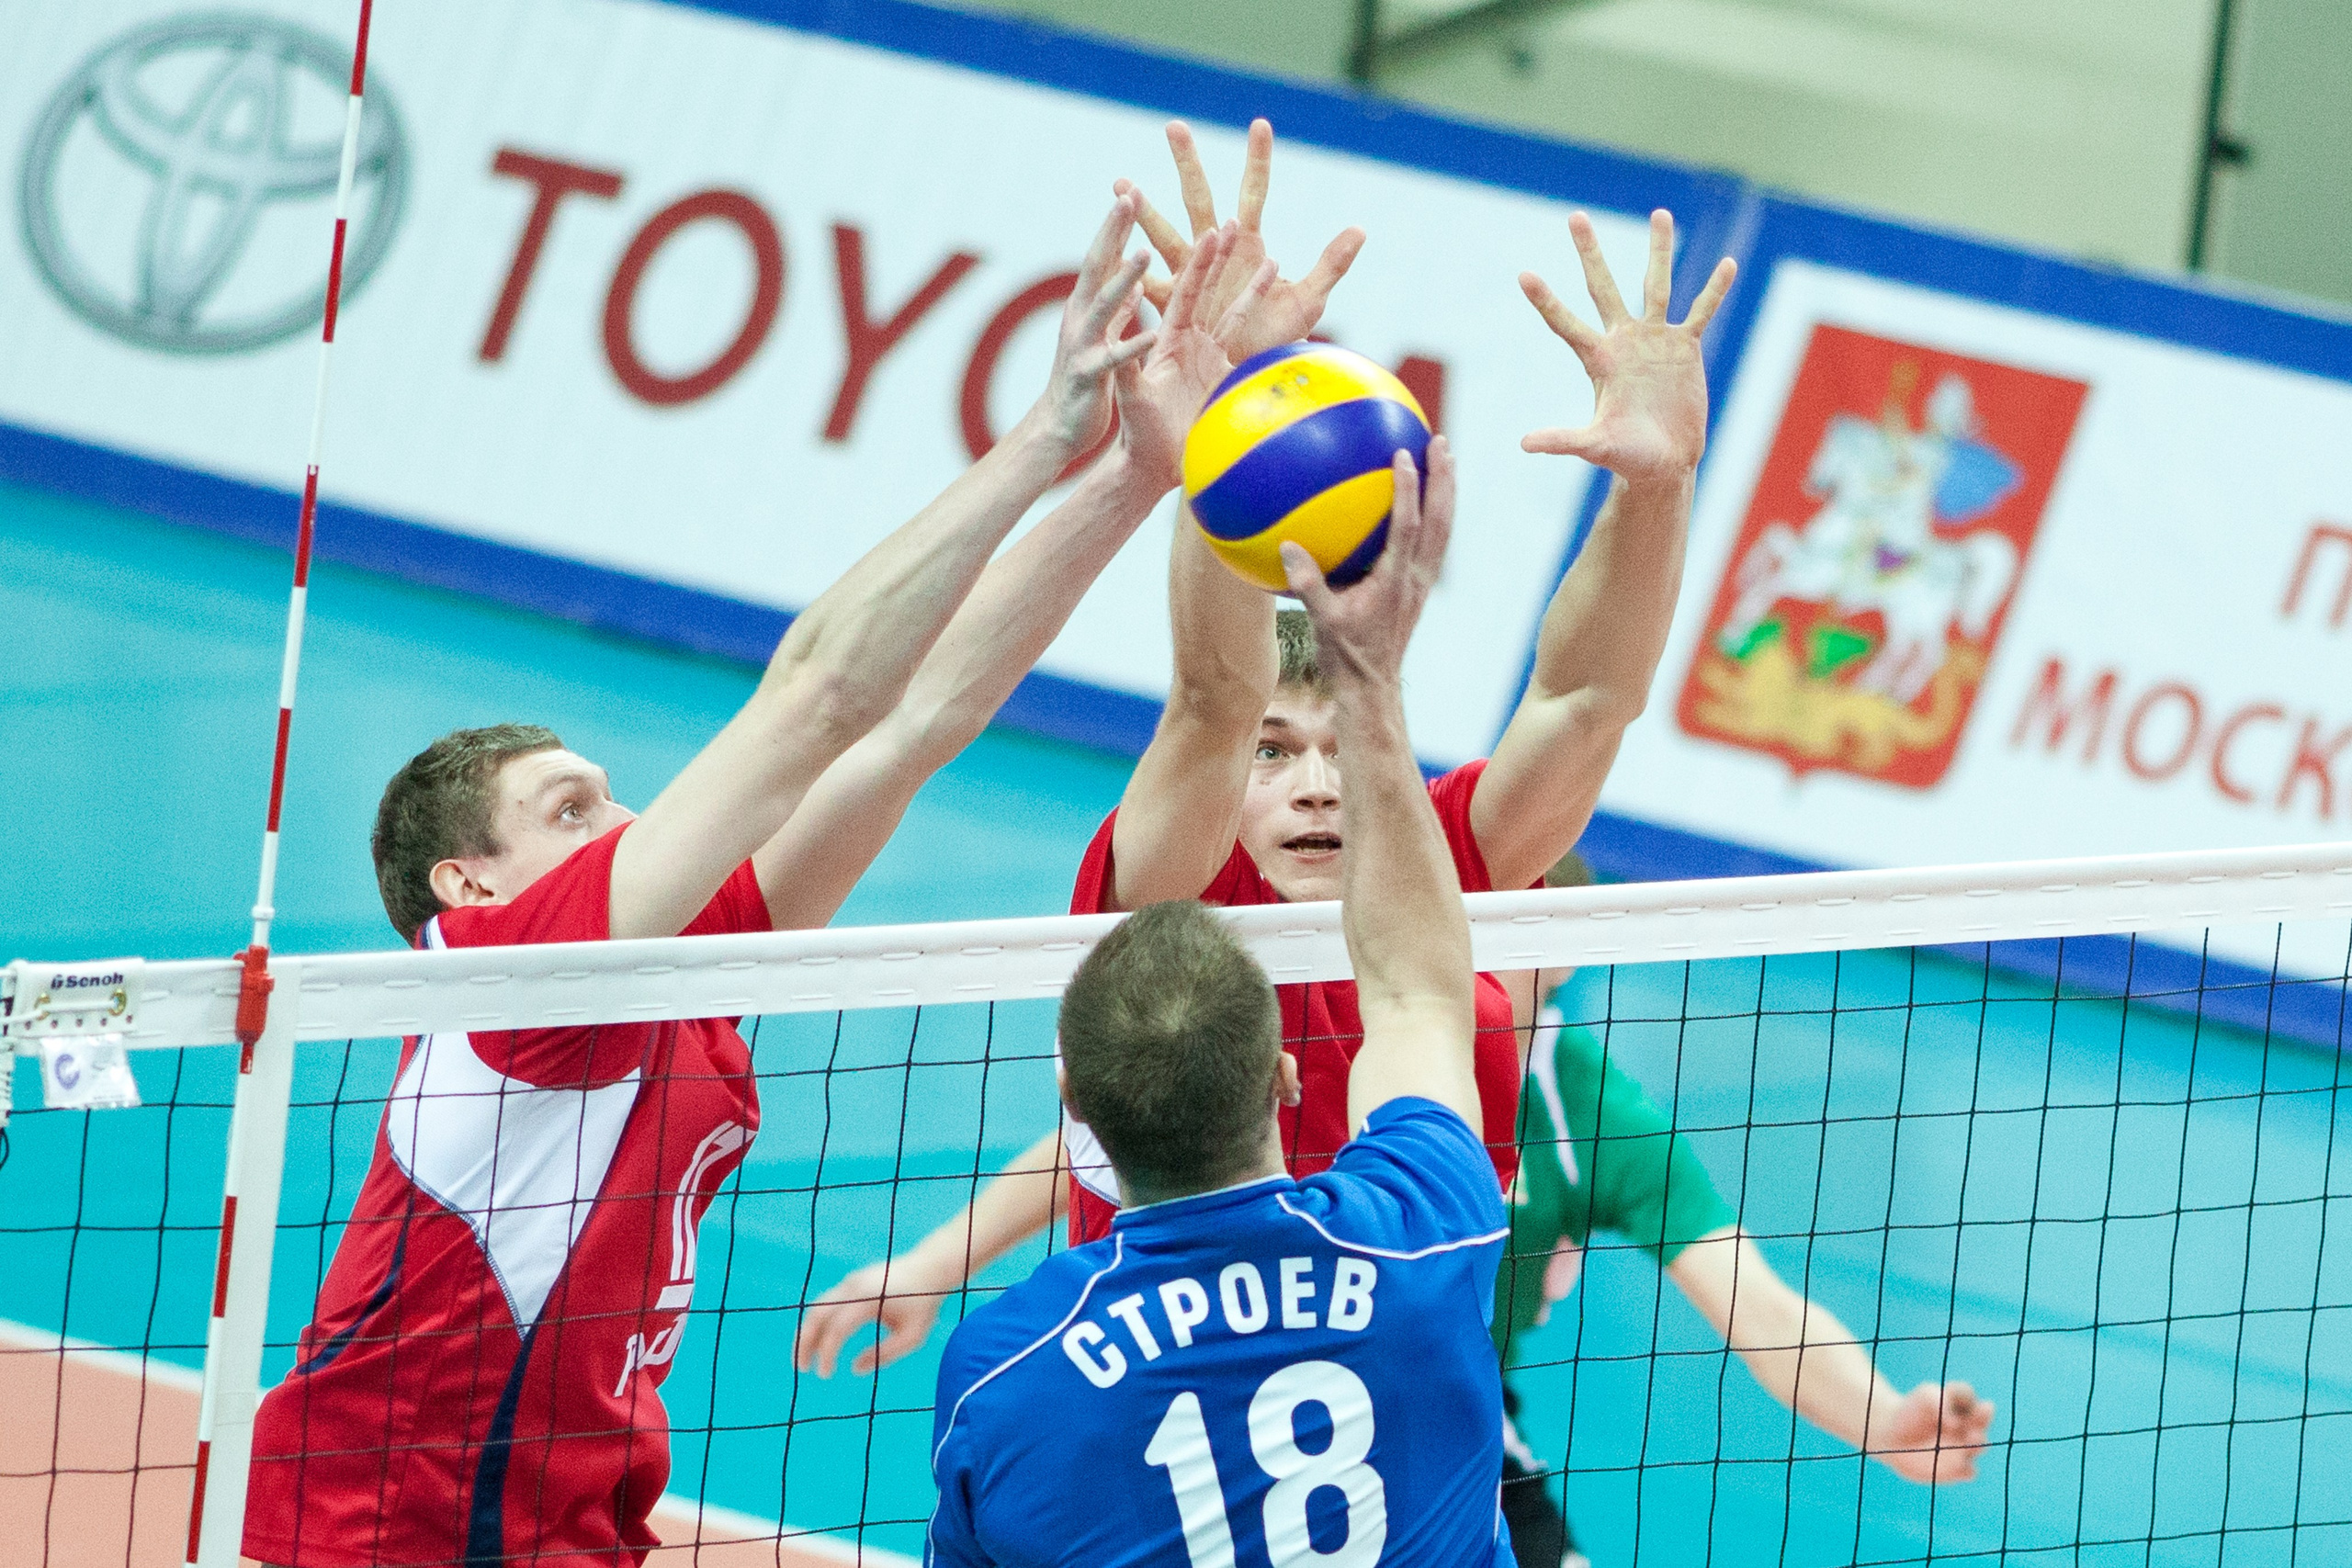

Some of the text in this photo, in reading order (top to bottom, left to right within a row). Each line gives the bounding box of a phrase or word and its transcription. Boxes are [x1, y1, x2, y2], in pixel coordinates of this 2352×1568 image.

[476, 145, 1446, 487] TOYO
[1061, 1256, 1378, 1389] СТРОЕВ
[1144, 1359, 1388, 1568] 18
